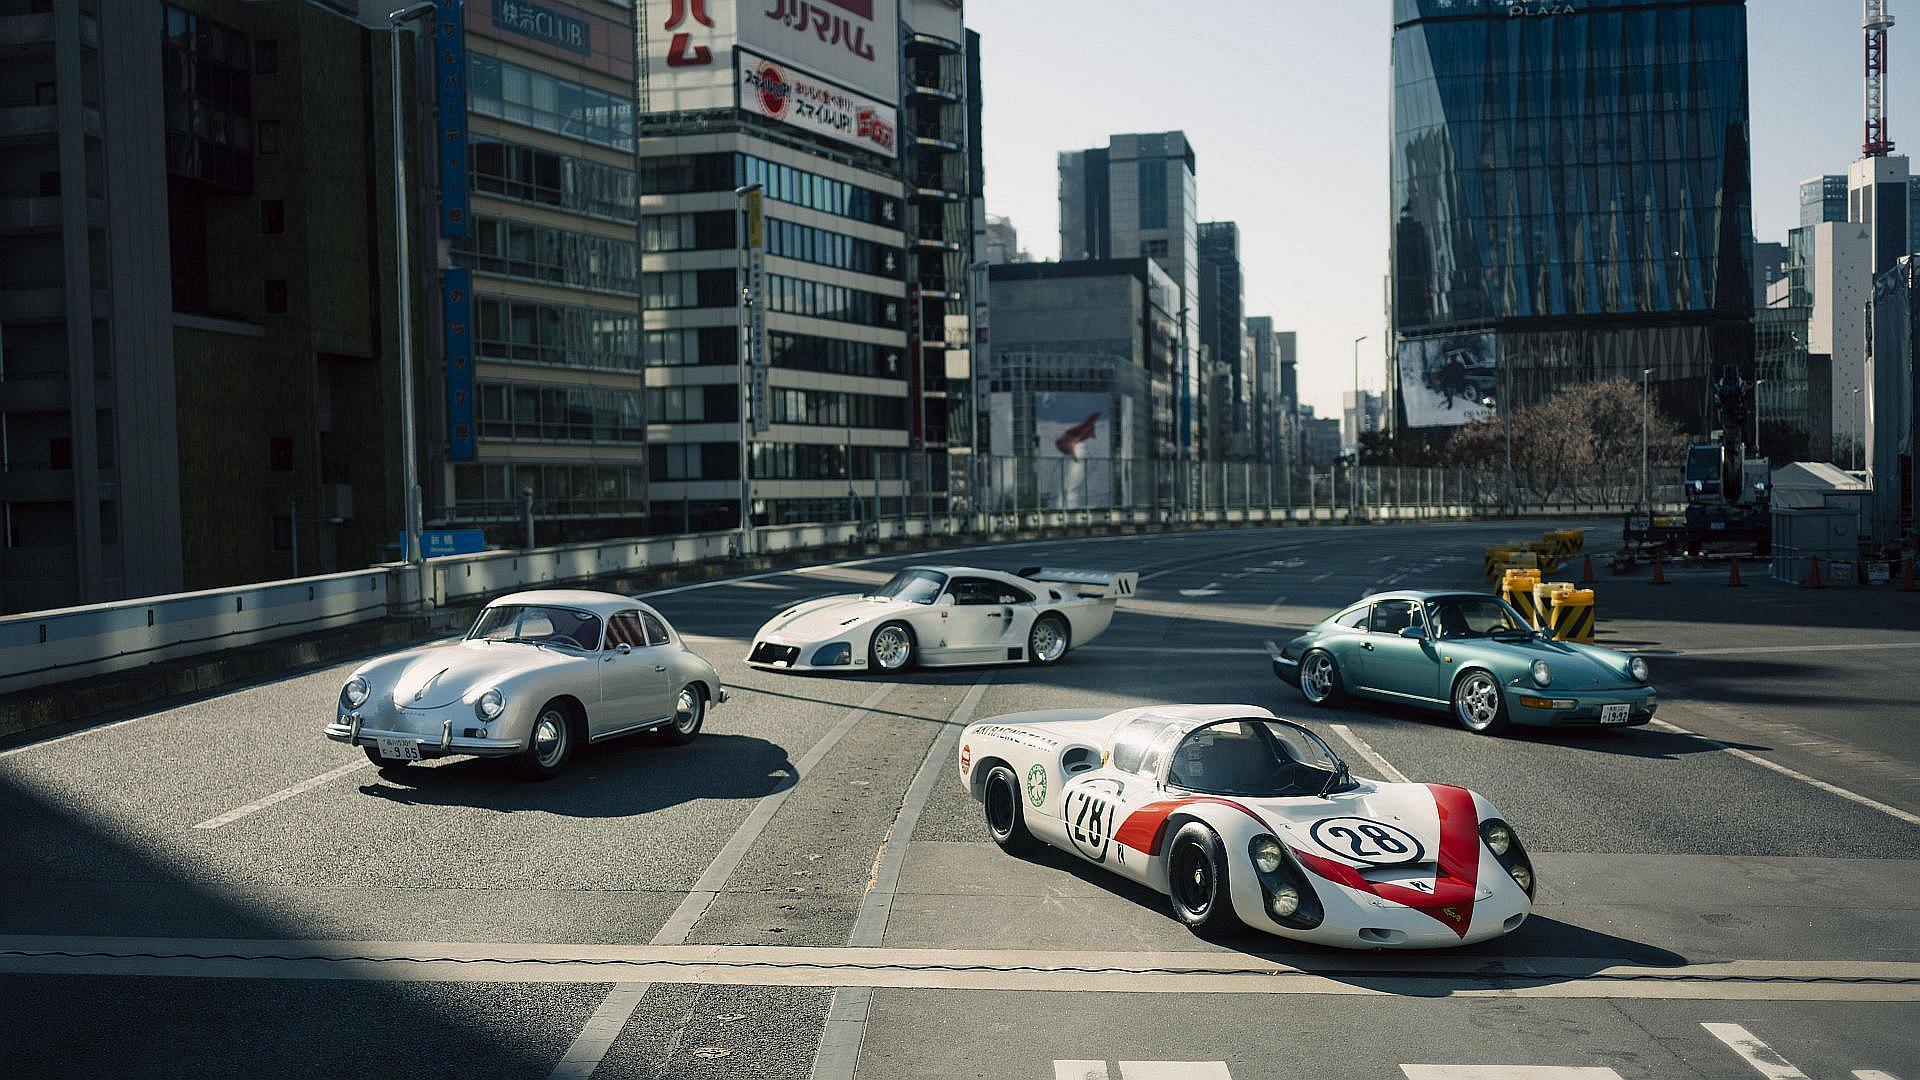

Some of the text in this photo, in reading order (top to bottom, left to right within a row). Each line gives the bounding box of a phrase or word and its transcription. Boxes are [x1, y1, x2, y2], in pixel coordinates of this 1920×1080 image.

[1509, 4, 1575, 17] PLAZA
[1075, 786, 1109, 847] 28
[1328, 824, 1408, 857] 28
